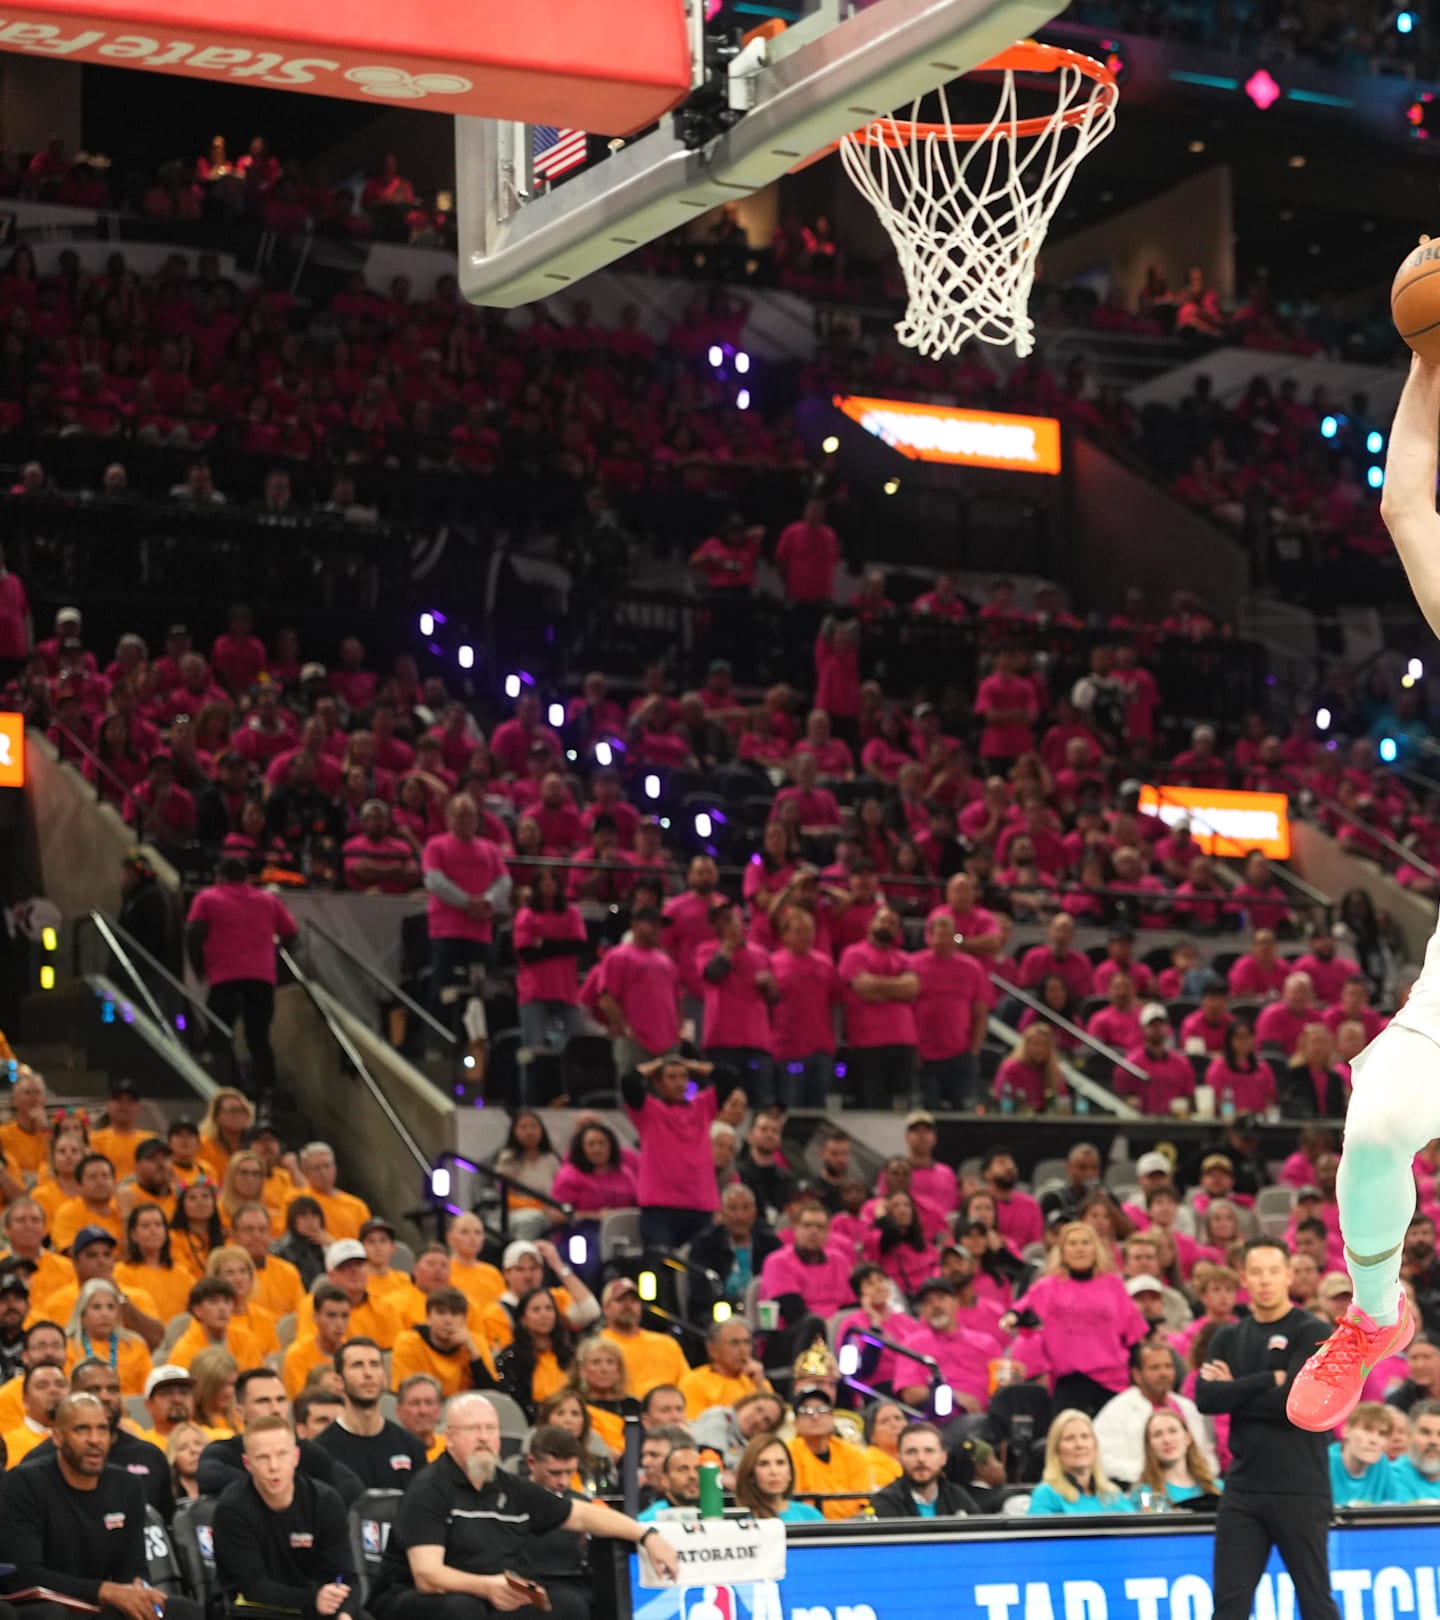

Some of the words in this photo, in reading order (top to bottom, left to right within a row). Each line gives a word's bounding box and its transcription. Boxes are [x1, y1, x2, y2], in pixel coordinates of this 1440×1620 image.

[0, 20, 106, 55] Fa
[98, 34, 340, 85] State
[677, 1545, 758, 1564] ATORADE
